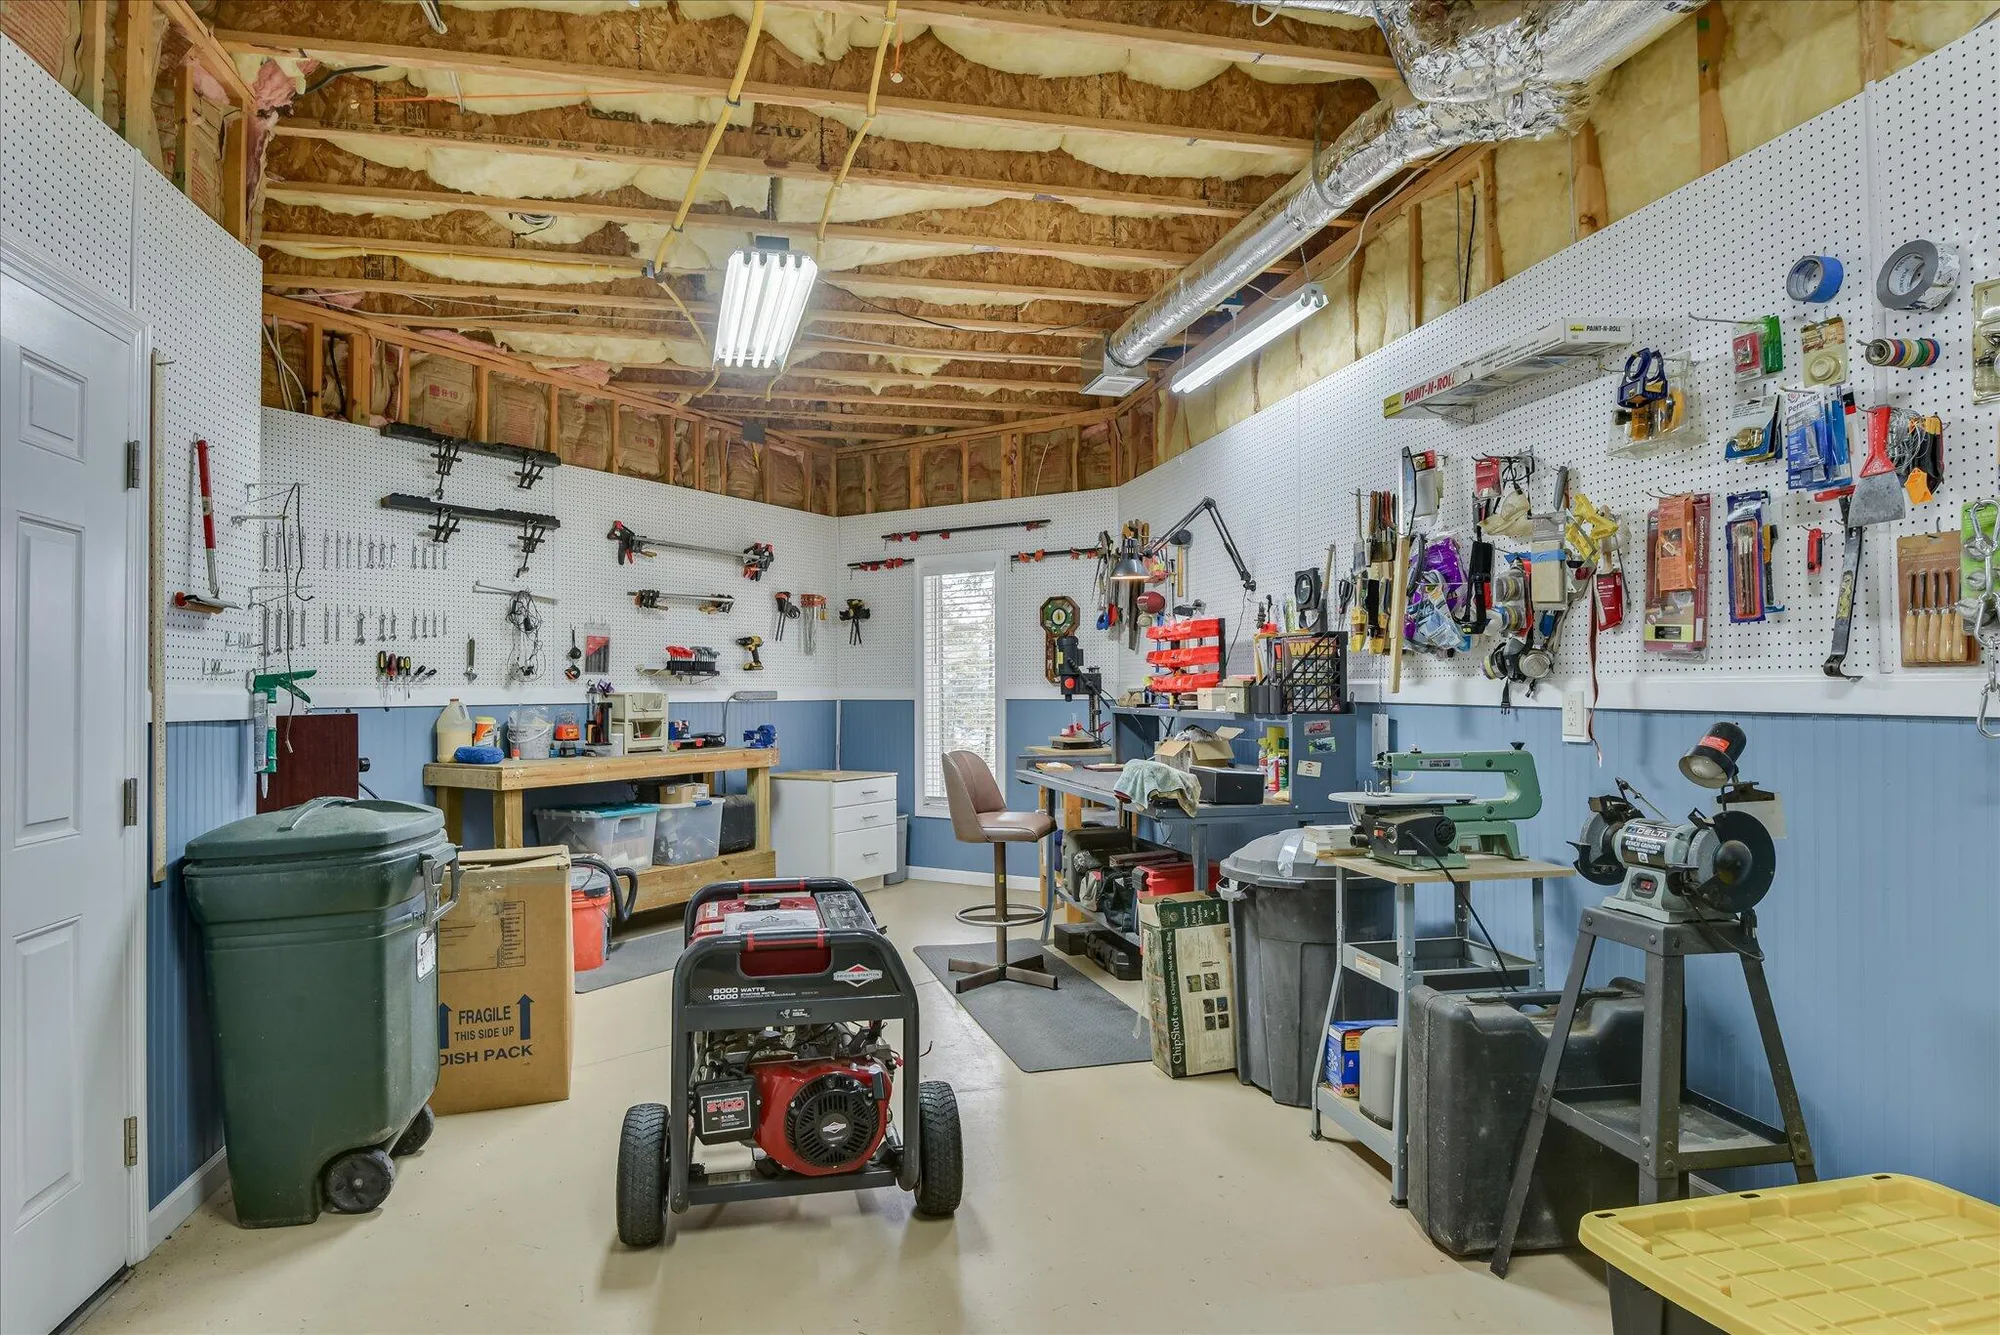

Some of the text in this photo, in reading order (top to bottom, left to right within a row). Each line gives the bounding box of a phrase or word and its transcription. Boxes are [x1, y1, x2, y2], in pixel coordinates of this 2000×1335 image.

[1636, 828, 1668, 838] DELTA
[708, 993, 739, 1001] 10000
[458, 1005, 512, 1026] FRAGILE
[454, 1025, 515, 1042] THIS SIDE UP
[1171, 1016, 1184, 1064] ChipShot
[440, 1044, 534, 1067] DISH PACK
